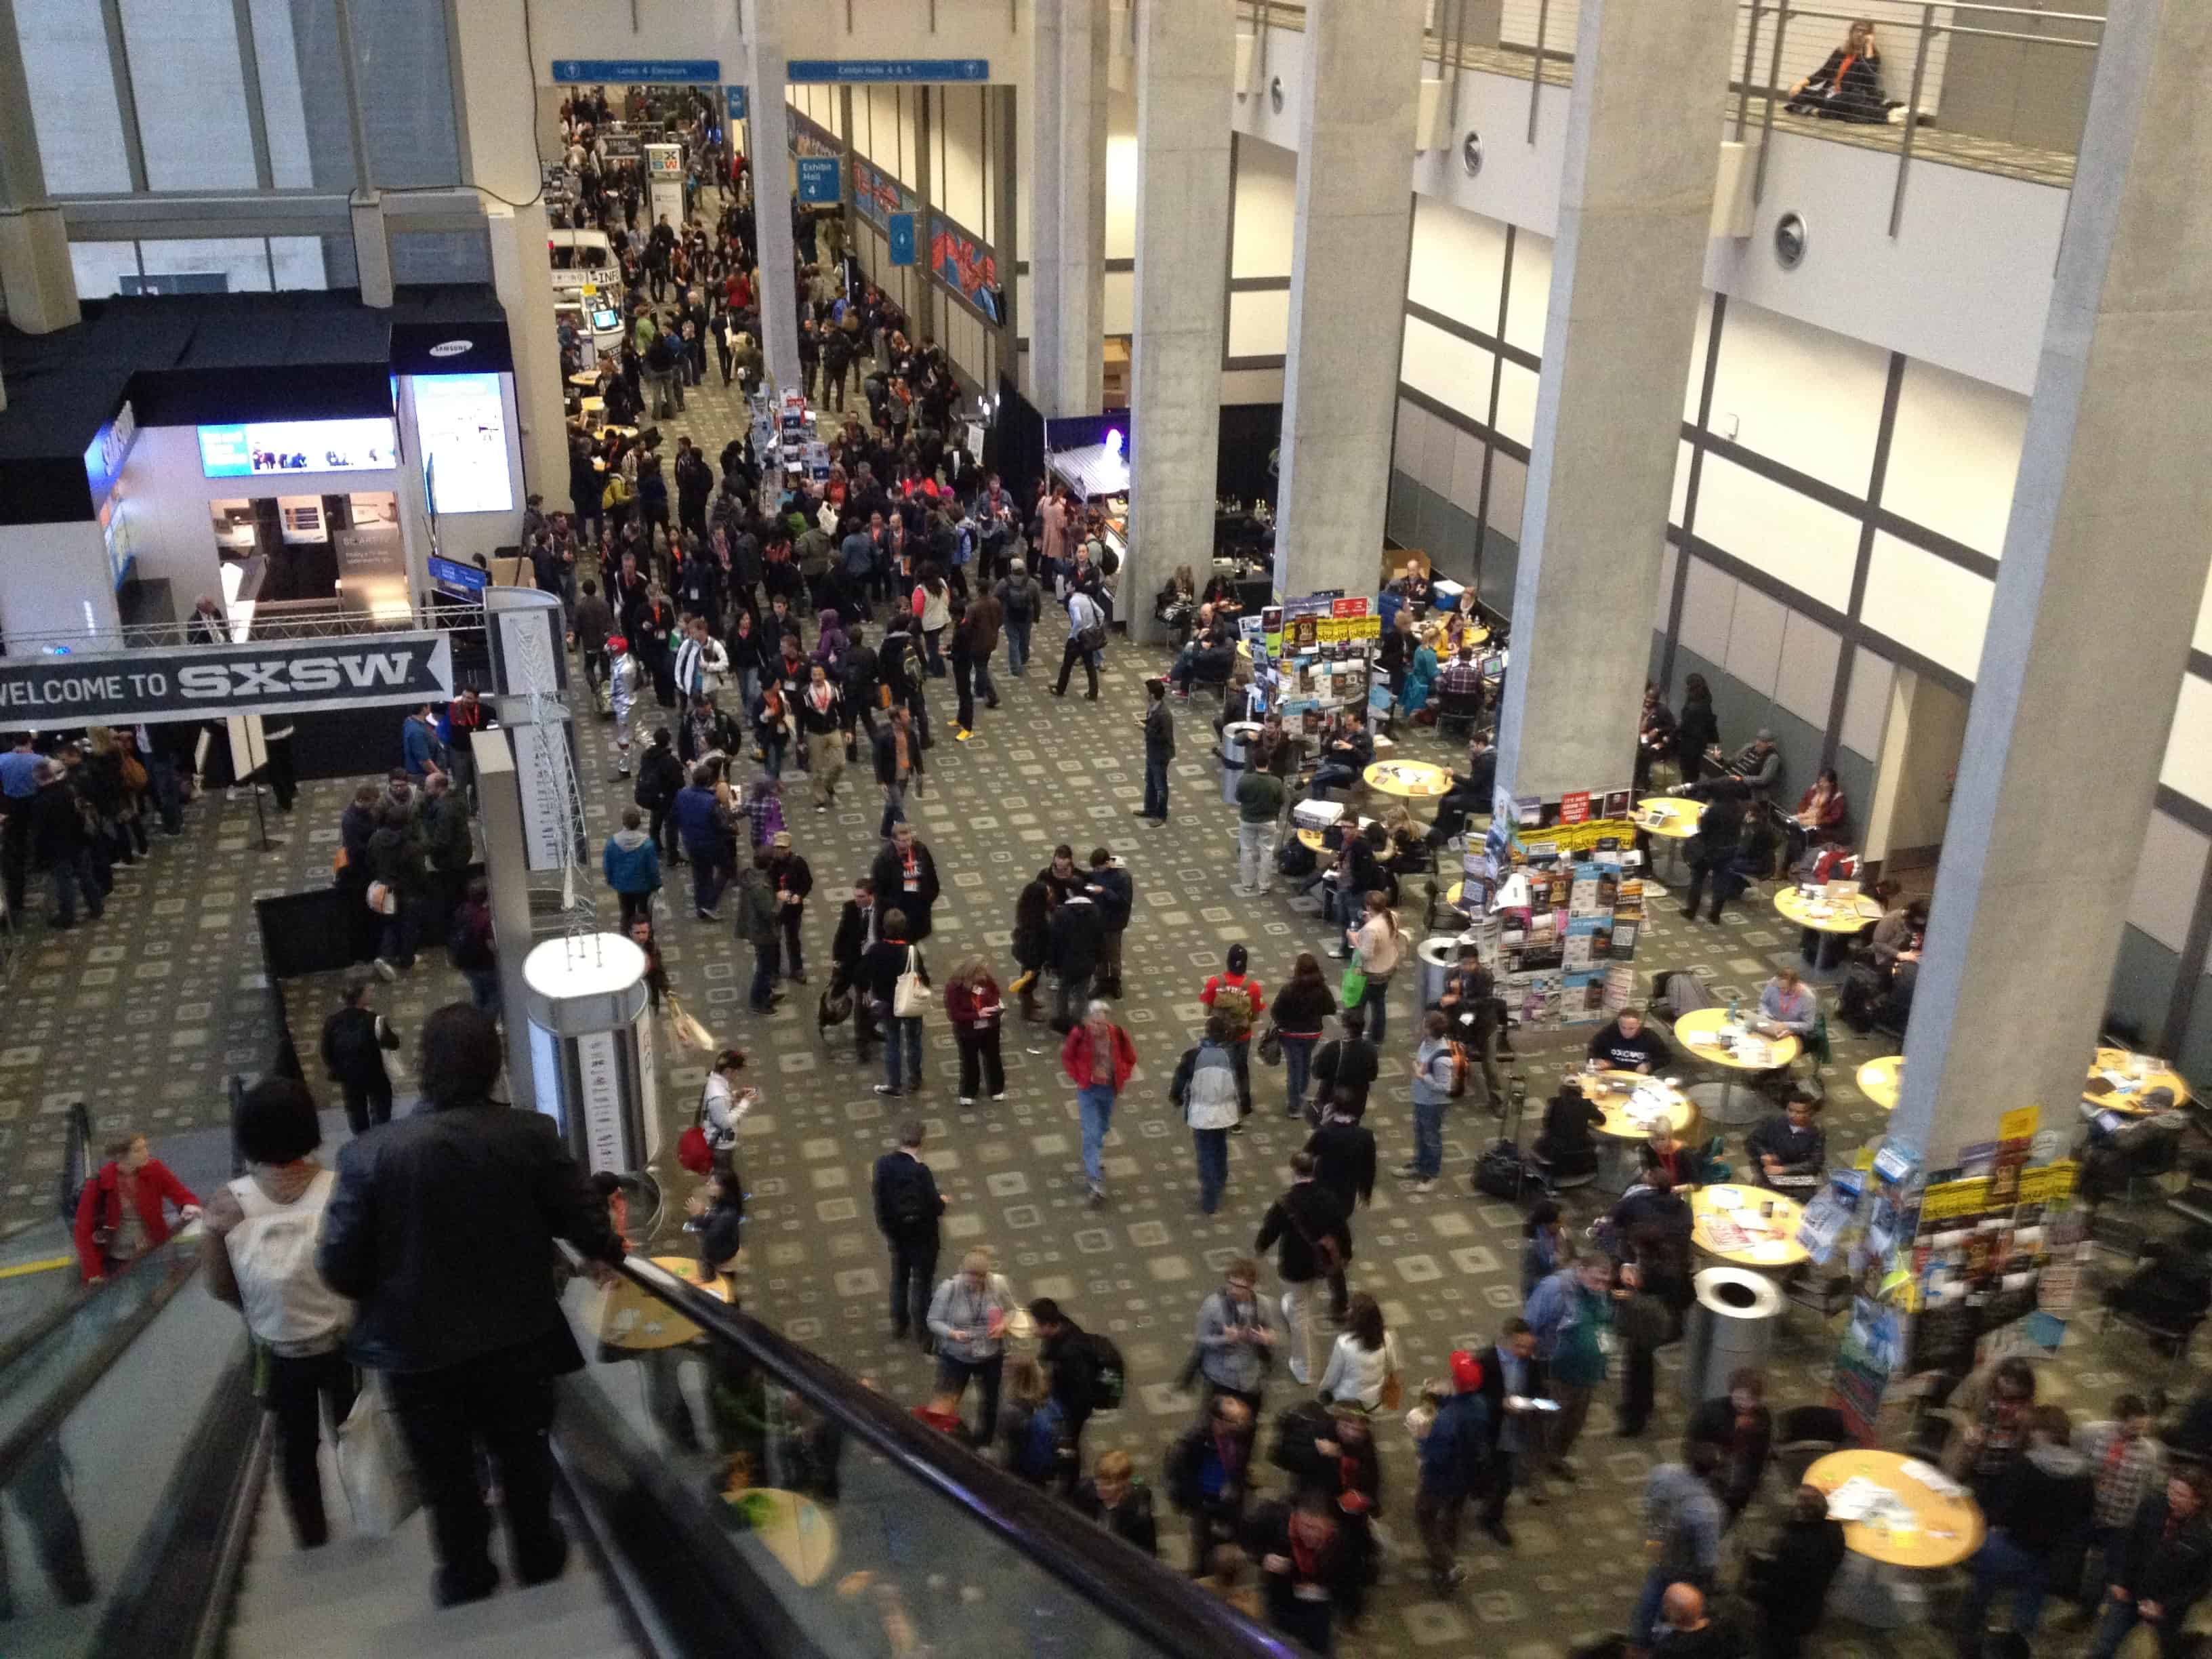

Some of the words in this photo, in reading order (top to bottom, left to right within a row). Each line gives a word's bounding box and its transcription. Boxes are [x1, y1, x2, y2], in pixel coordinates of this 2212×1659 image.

[802, 163, 832, 171] Exhibit
[802, 172, 820, 180] Hall
[808, 185, 815, 195] 4
[128, 674, 167, 697] TO
[178, 651, 413, 699] SXSW
